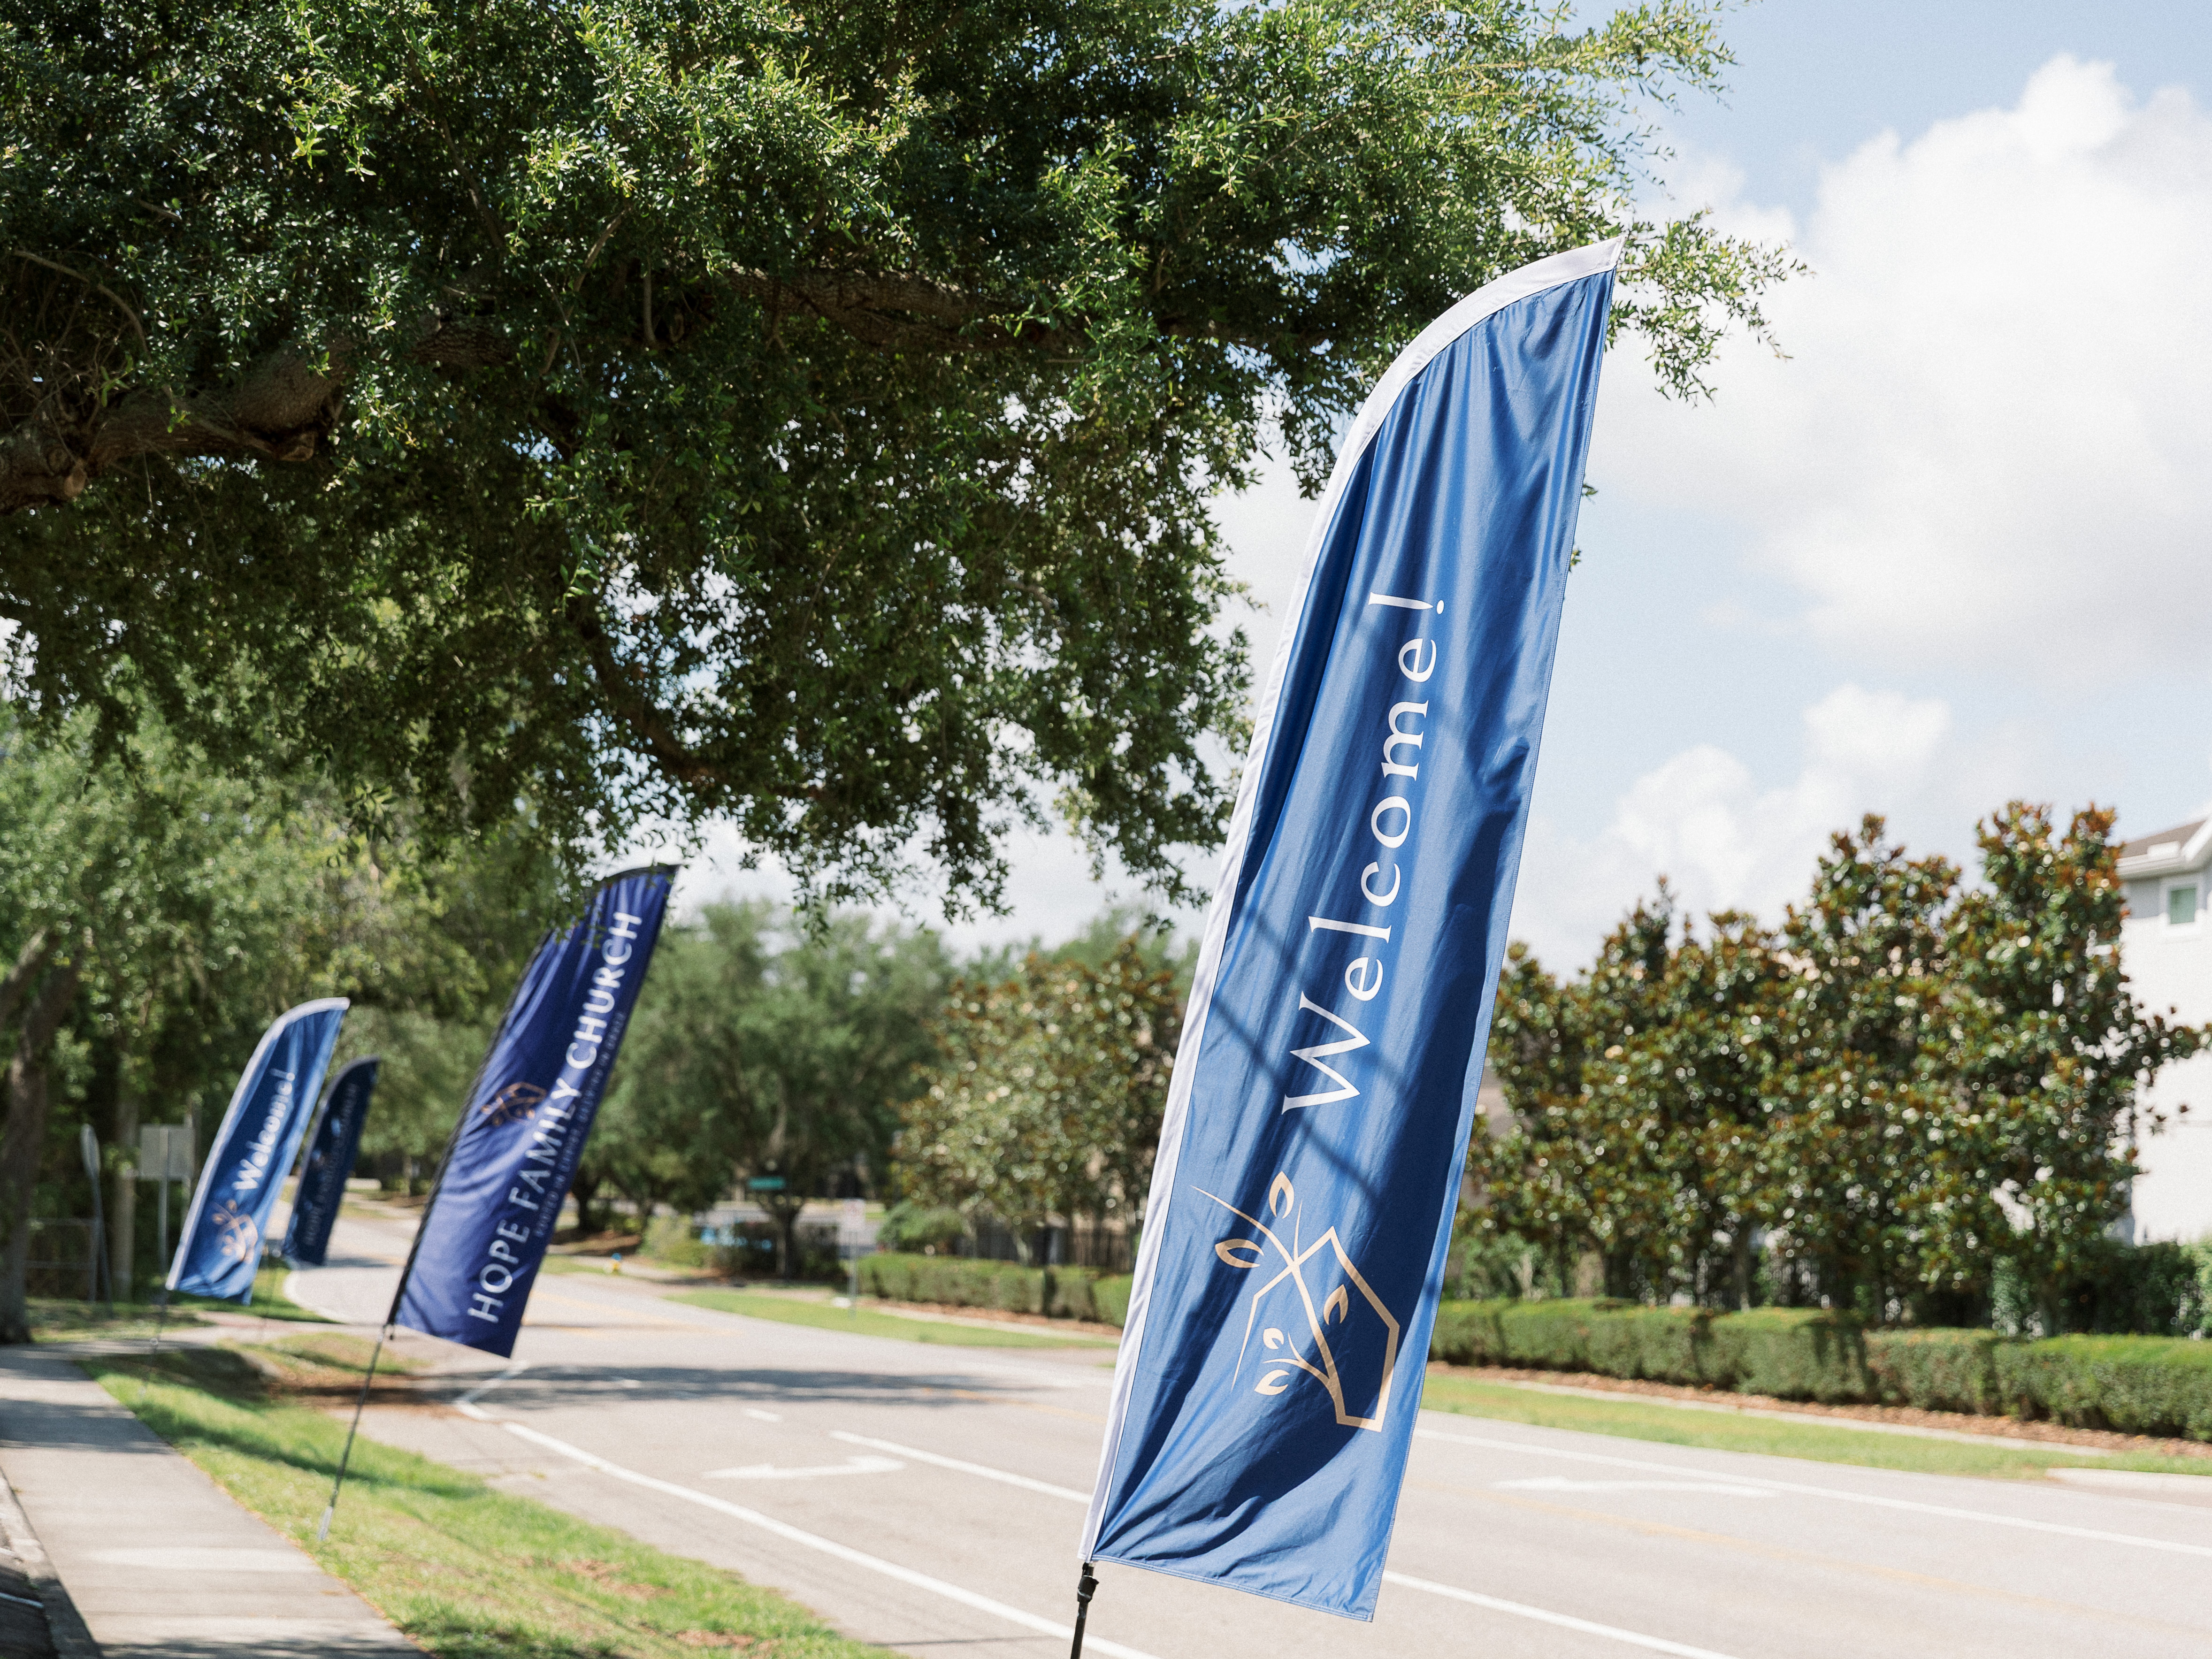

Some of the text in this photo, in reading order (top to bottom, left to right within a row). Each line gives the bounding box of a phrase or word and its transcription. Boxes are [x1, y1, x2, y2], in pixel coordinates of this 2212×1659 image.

[1282, 592, 1445, 1115] Welcome!
[233, 1068, 295, 1190] Welcome!
[468, 911, 643, 1323] HOPE FAMILY CHURCH
